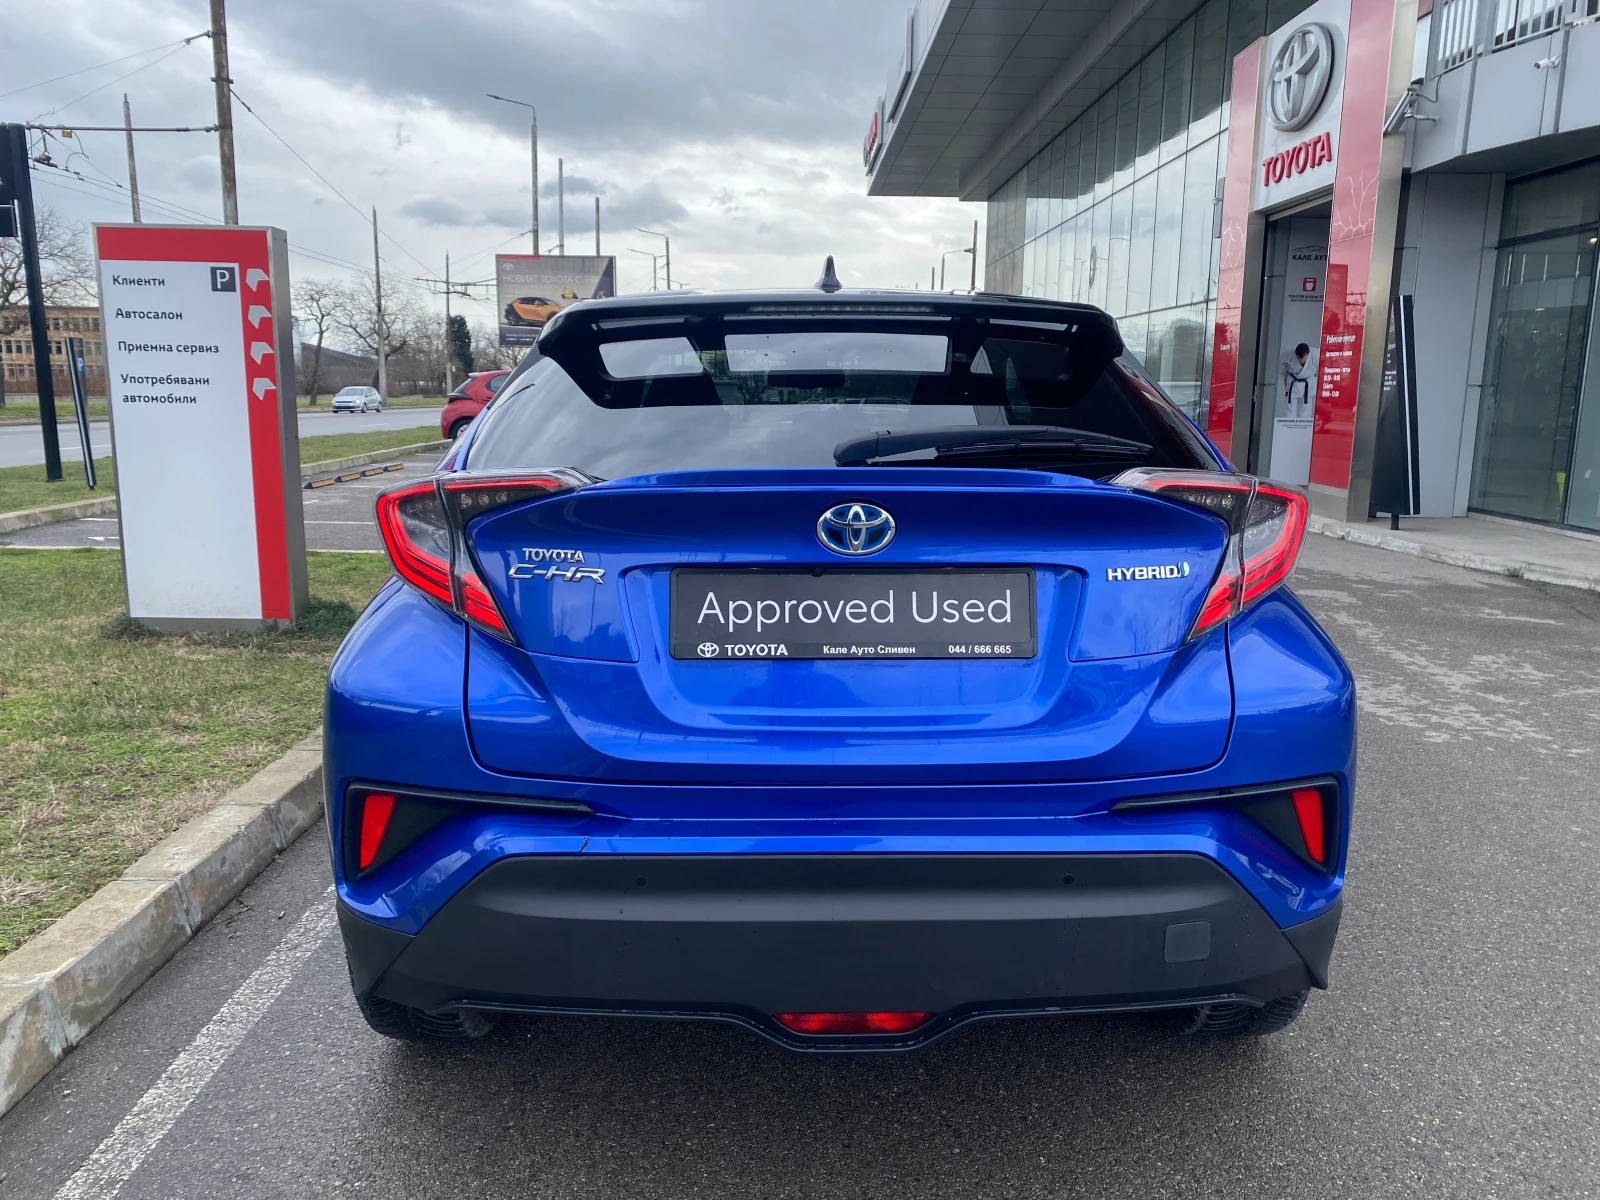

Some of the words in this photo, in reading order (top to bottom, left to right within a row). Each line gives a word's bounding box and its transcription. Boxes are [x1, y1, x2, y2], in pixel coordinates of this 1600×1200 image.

[1262, 131, 1332, 187] TOYOTA
[112, 274, 165, 286] Клиенти
[502, 274, 538, 283] НОВИЯТ
[540, 275, 573, 283] TOYOTA
[115, 308, 183, 320] Автосалон
[118, 340, 173, 354] Приемна
[176, 344, 219, 355] сервиз
[120, 373, 210, 387] Употребявани
[122, 393, 197, 404] автомобили
[522, 548, 586, 564] TOYOTA
[508, 563, 606, 584] C-HR
[1106, 566, 1180, 581] HYBRID
[697, 590, 895, 632] Approved
[911, 590, 1012, 624] Used
[724, 643, 789, 656] TOYOTA
[823, 645, 847, 654] Кале
[850, 645, 875, 655] Ауто
[877, 645, 916, 654] Сливен
[948, 645, 966, 654] 044
[974, 645, 992, 654] 666
[994, 645, 1012, 654] 665
